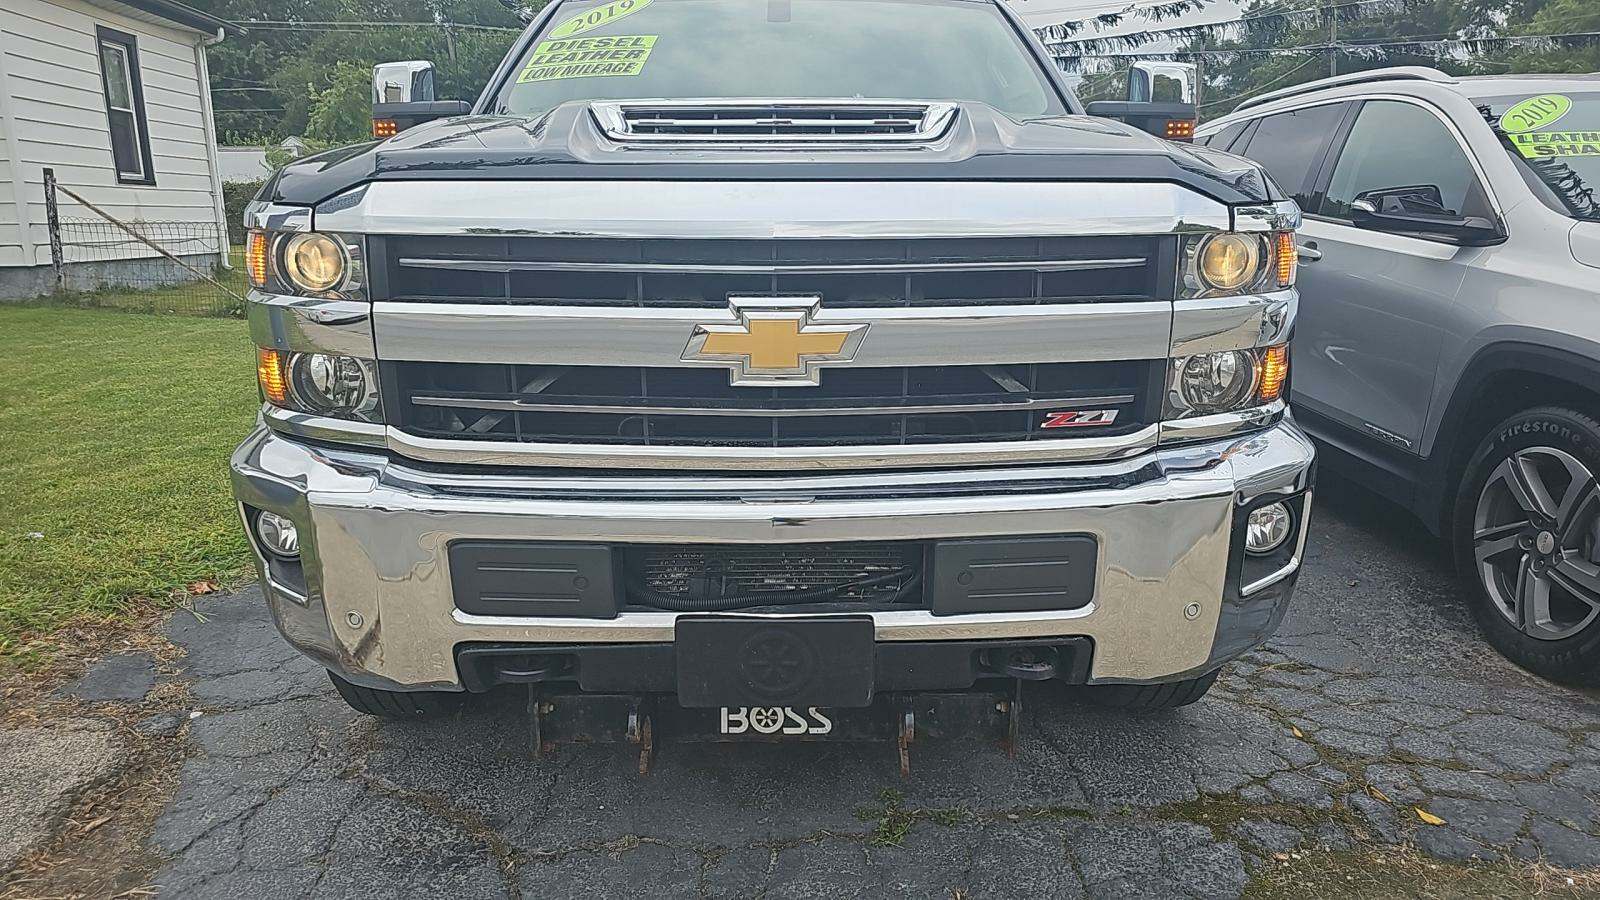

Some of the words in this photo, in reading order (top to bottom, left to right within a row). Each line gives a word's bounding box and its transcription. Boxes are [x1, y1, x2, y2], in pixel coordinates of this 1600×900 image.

[571, 0, 635, 33] 2019
[547, 37, 645, 52] DIESEL
[532, 49, 645, 66] LEATHER
[1512, 97, 1558, 128] 2019
[1517, 132, 1600, 143] LEATH
[1040, 409, 1120, 428] Z71
[720, 706, 832, 734] BOSS
